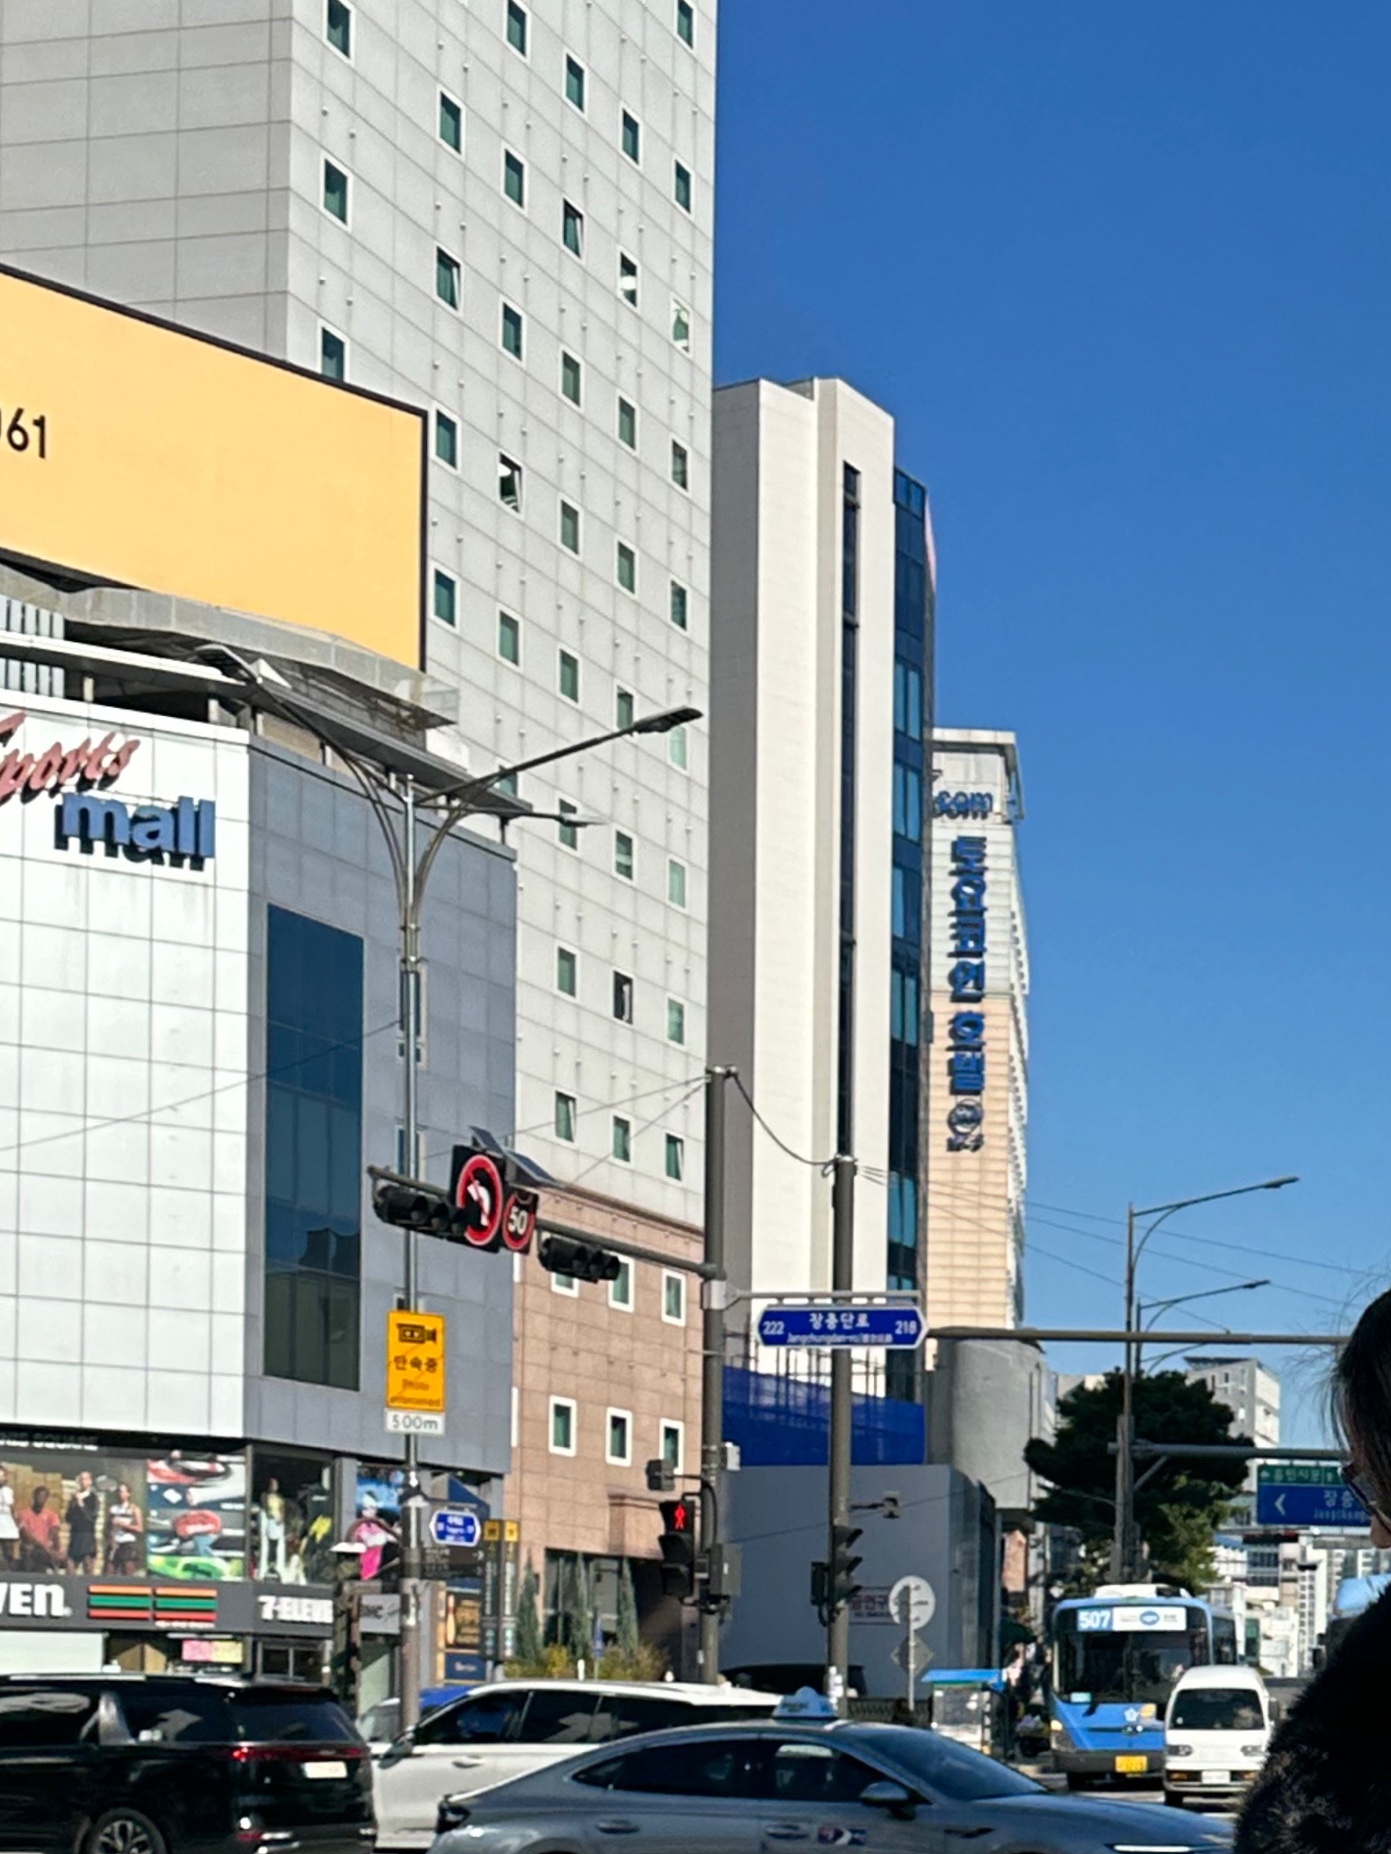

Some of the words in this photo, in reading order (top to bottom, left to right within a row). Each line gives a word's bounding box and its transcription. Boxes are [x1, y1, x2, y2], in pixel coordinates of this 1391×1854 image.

[0, 406, 46, 459] 61
[62, 792, 215, 860] mall
[507, 1206, 528, 1233] 50
[762, 1320, 785, 1336] 222
[809, 1312, 870, 1331] 장충단로
[393, 1354, 439, 1373] 단속중
[392, 1414, 439, 1430] 500m
[1078, 1610, 1111, 1630] 507
